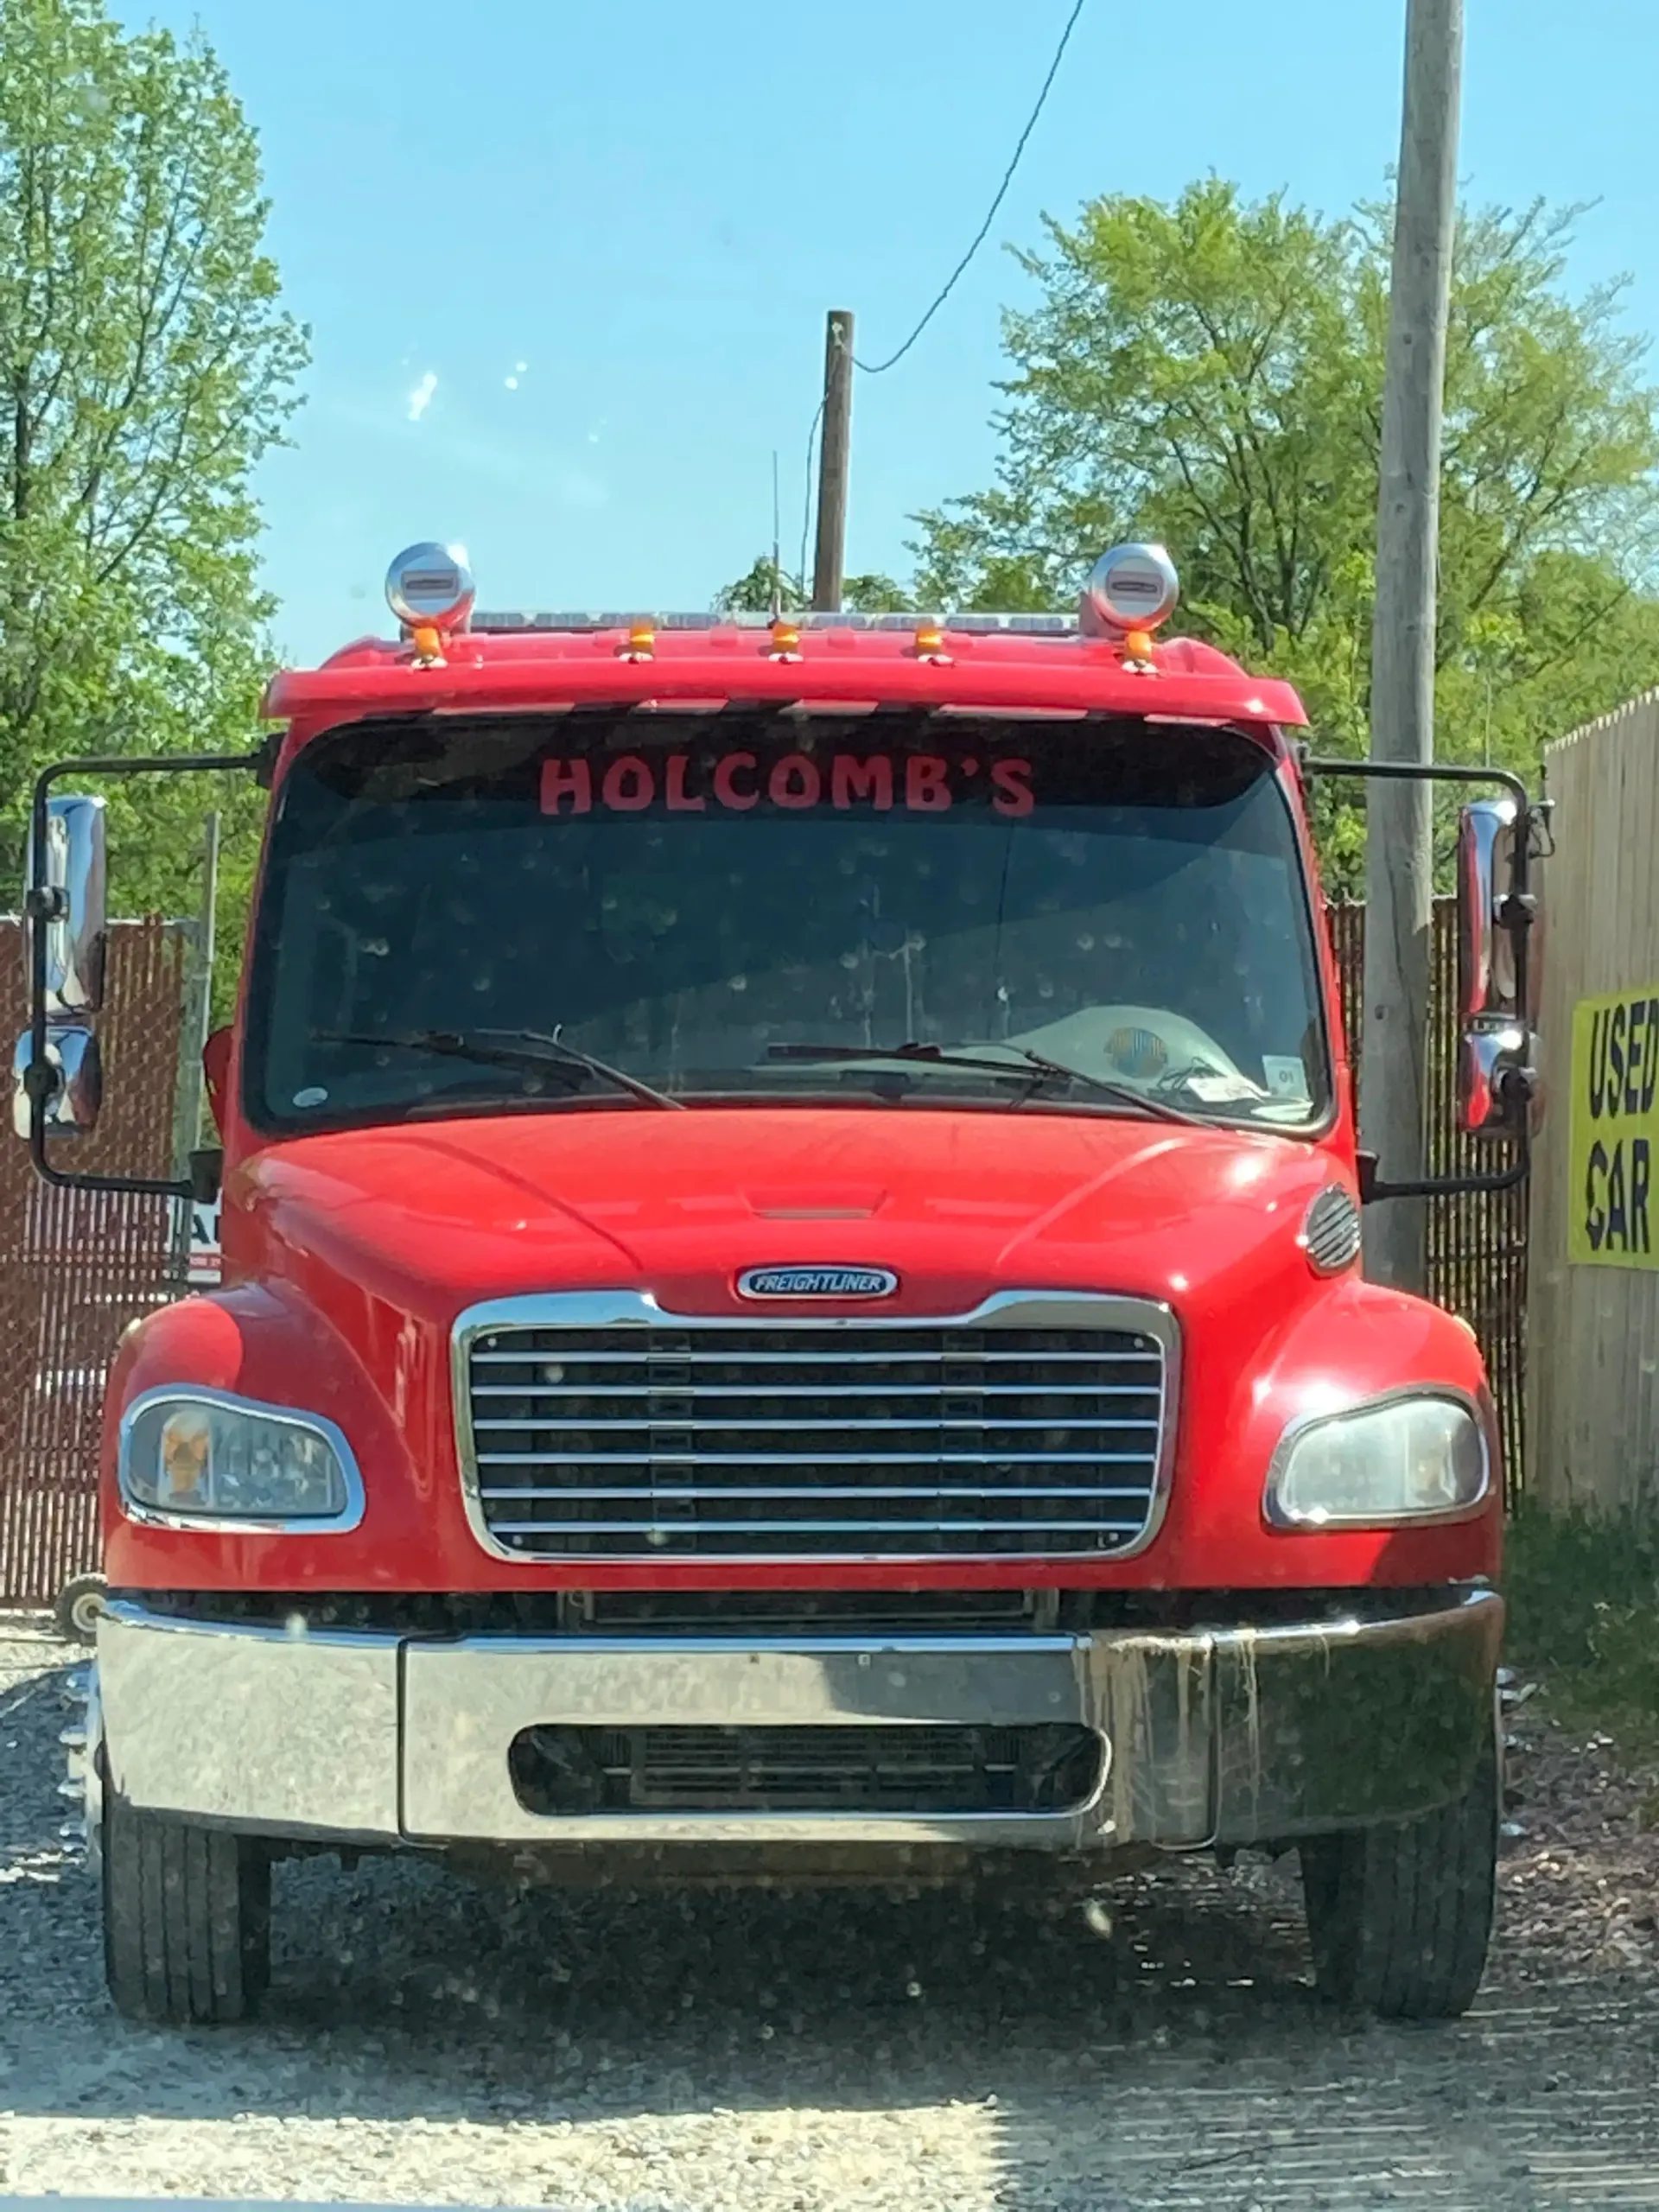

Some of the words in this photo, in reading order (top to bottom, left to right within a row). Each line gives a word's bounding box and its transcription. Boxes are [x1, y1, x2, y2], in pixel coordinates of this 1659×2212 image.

[540, 752, 1034, 817] HOLCOMB'S
[1590, 998, 1659, 1119] USED
[1586, 1138, 1650, 1253] CAR
[755, 1273, 880, 1291] FREIGHTLINER
